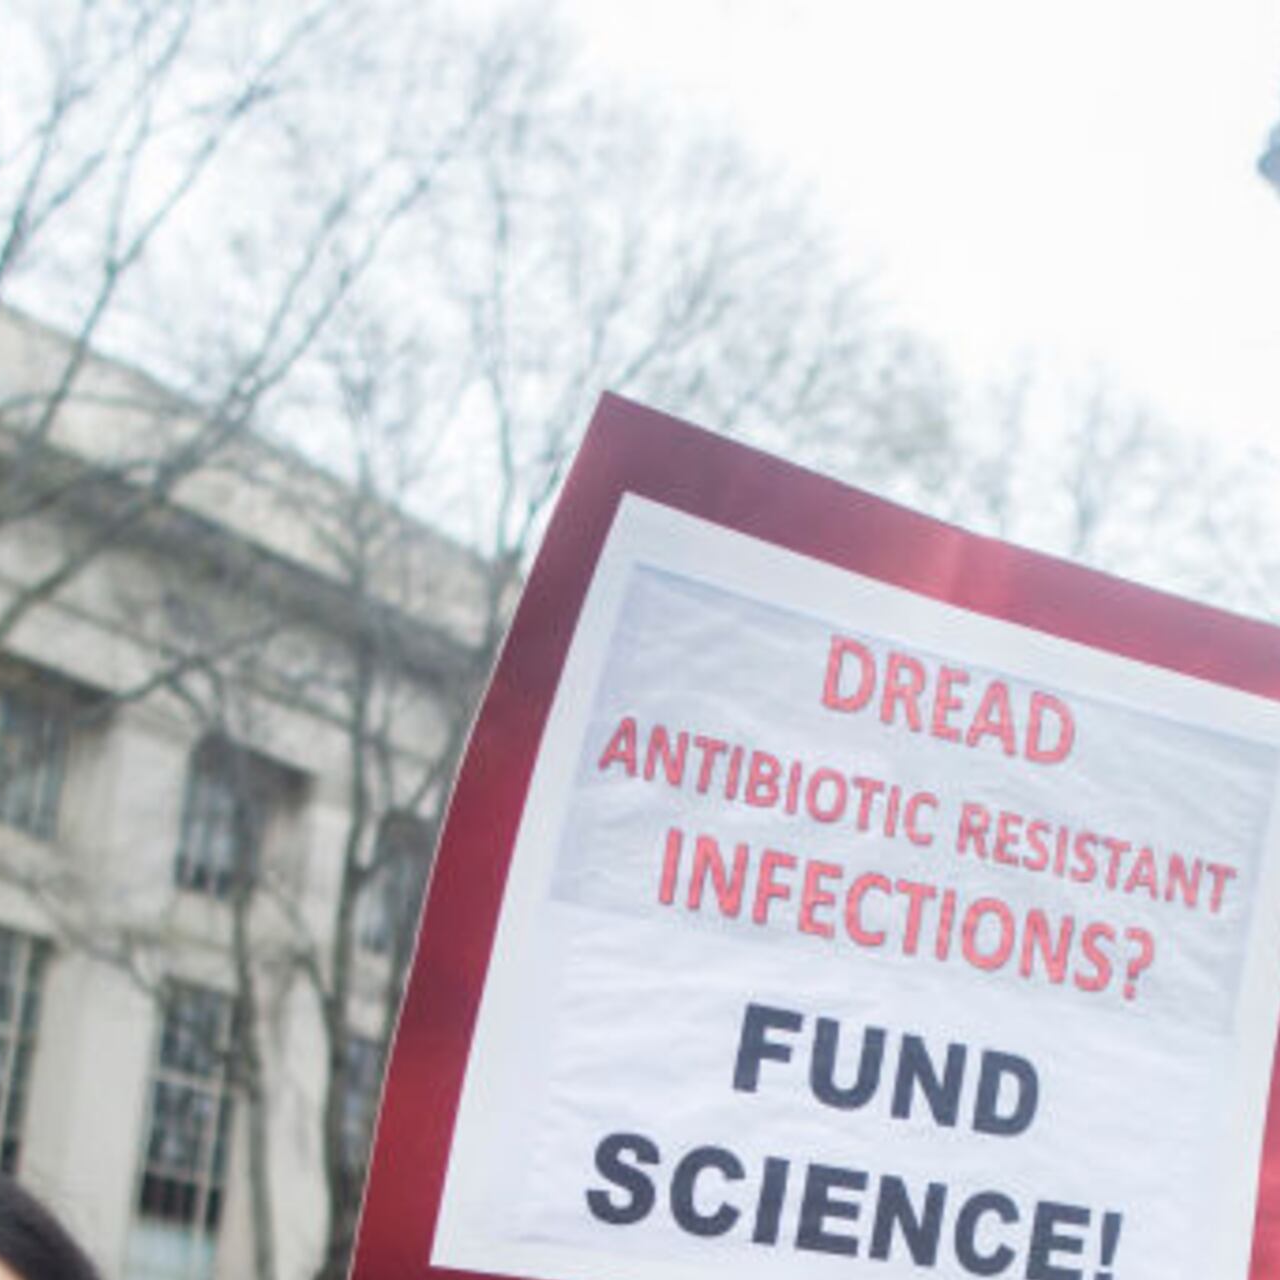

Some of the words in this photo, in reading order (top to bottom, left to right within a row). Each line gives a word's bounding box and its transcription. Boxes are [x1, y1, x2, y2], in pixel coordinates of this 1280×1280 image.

[820, 634, 1077, 767] DREAD
[598, 716, 938, 849] ANTIBIOTIC
[956, 802, 1236, 914] RESISTANT
[657, 827, 1156, 1000] INFECTIONS?
[731, 1003, 1040, 1137] FUND
